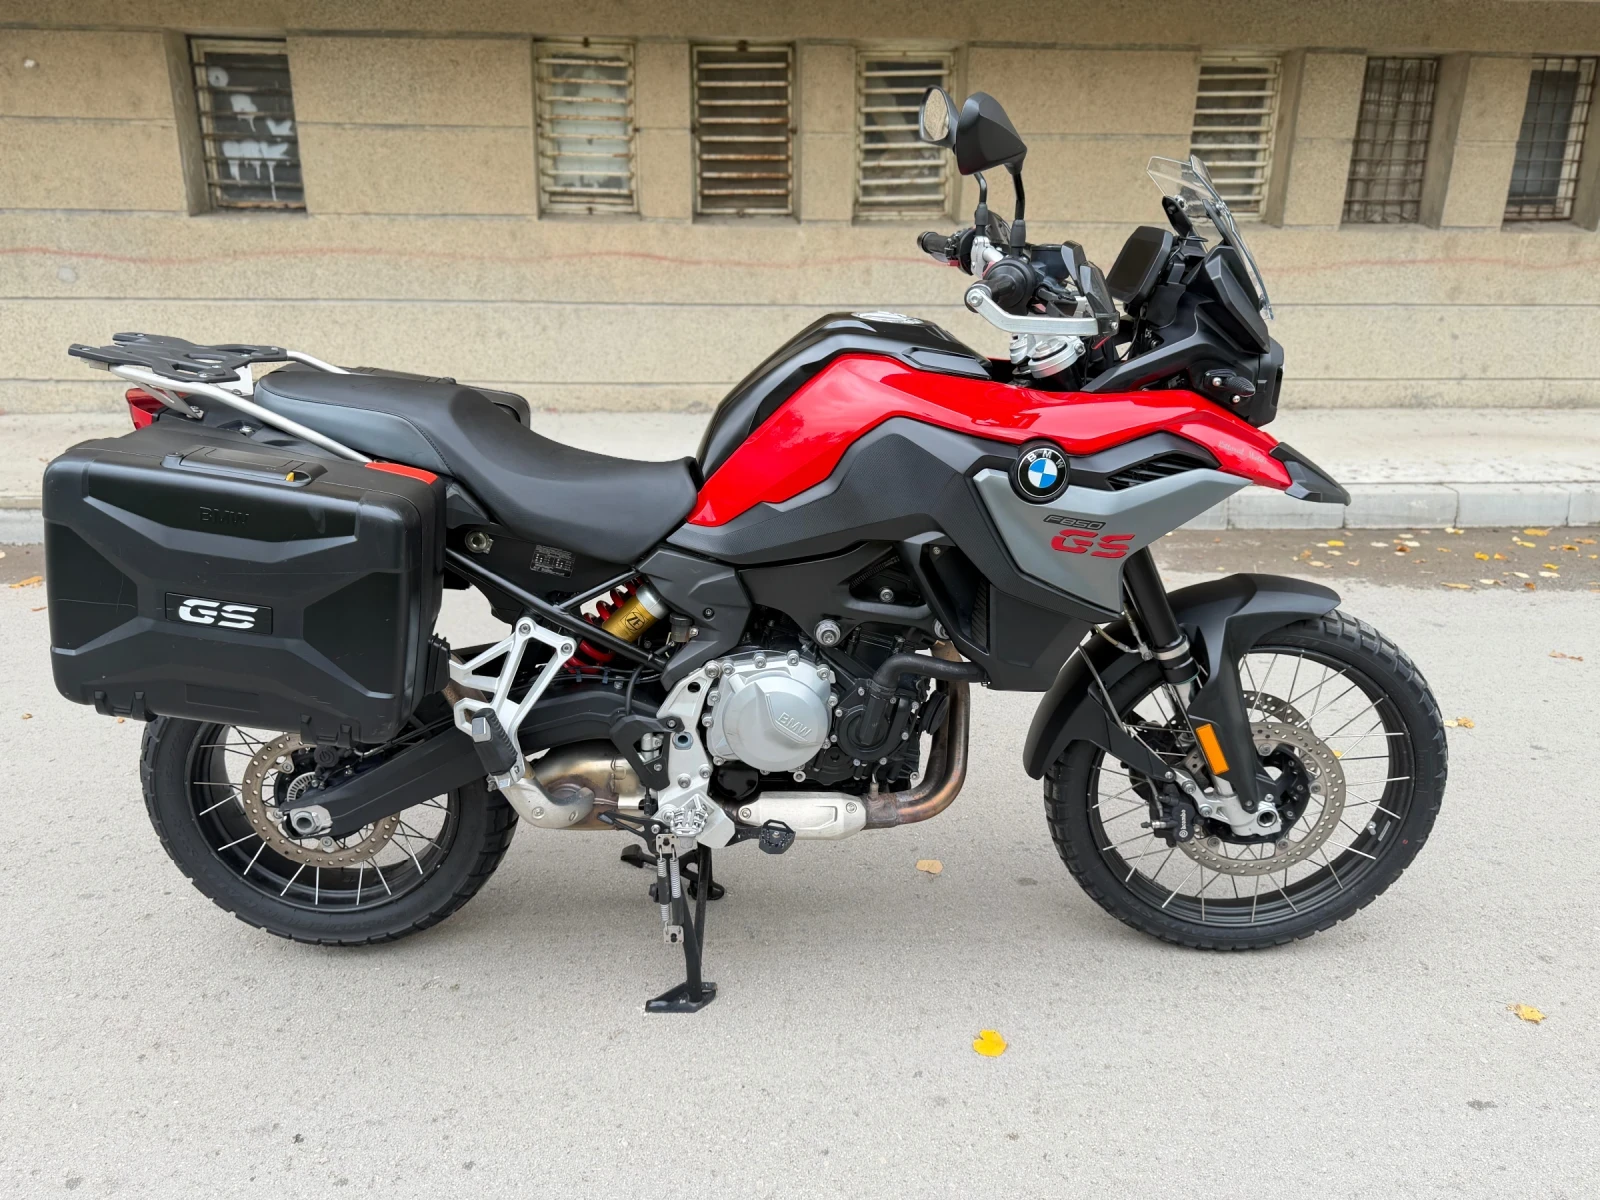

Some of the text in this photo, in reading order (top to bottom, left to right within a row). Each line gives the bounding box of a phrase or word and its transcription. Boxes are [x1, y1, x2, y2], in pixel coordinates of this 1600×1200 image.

[1027, 450, 1066, 469] BMW
[200, 506, 250, 524] BMW
[1046, 515, 1104, 530] F850
[1051, 529, 1135, 559] GS
[178, 599, 259, 629] GS
[626, 612, 646, 631] ZF
[778, 711, 812, 737] BMW
